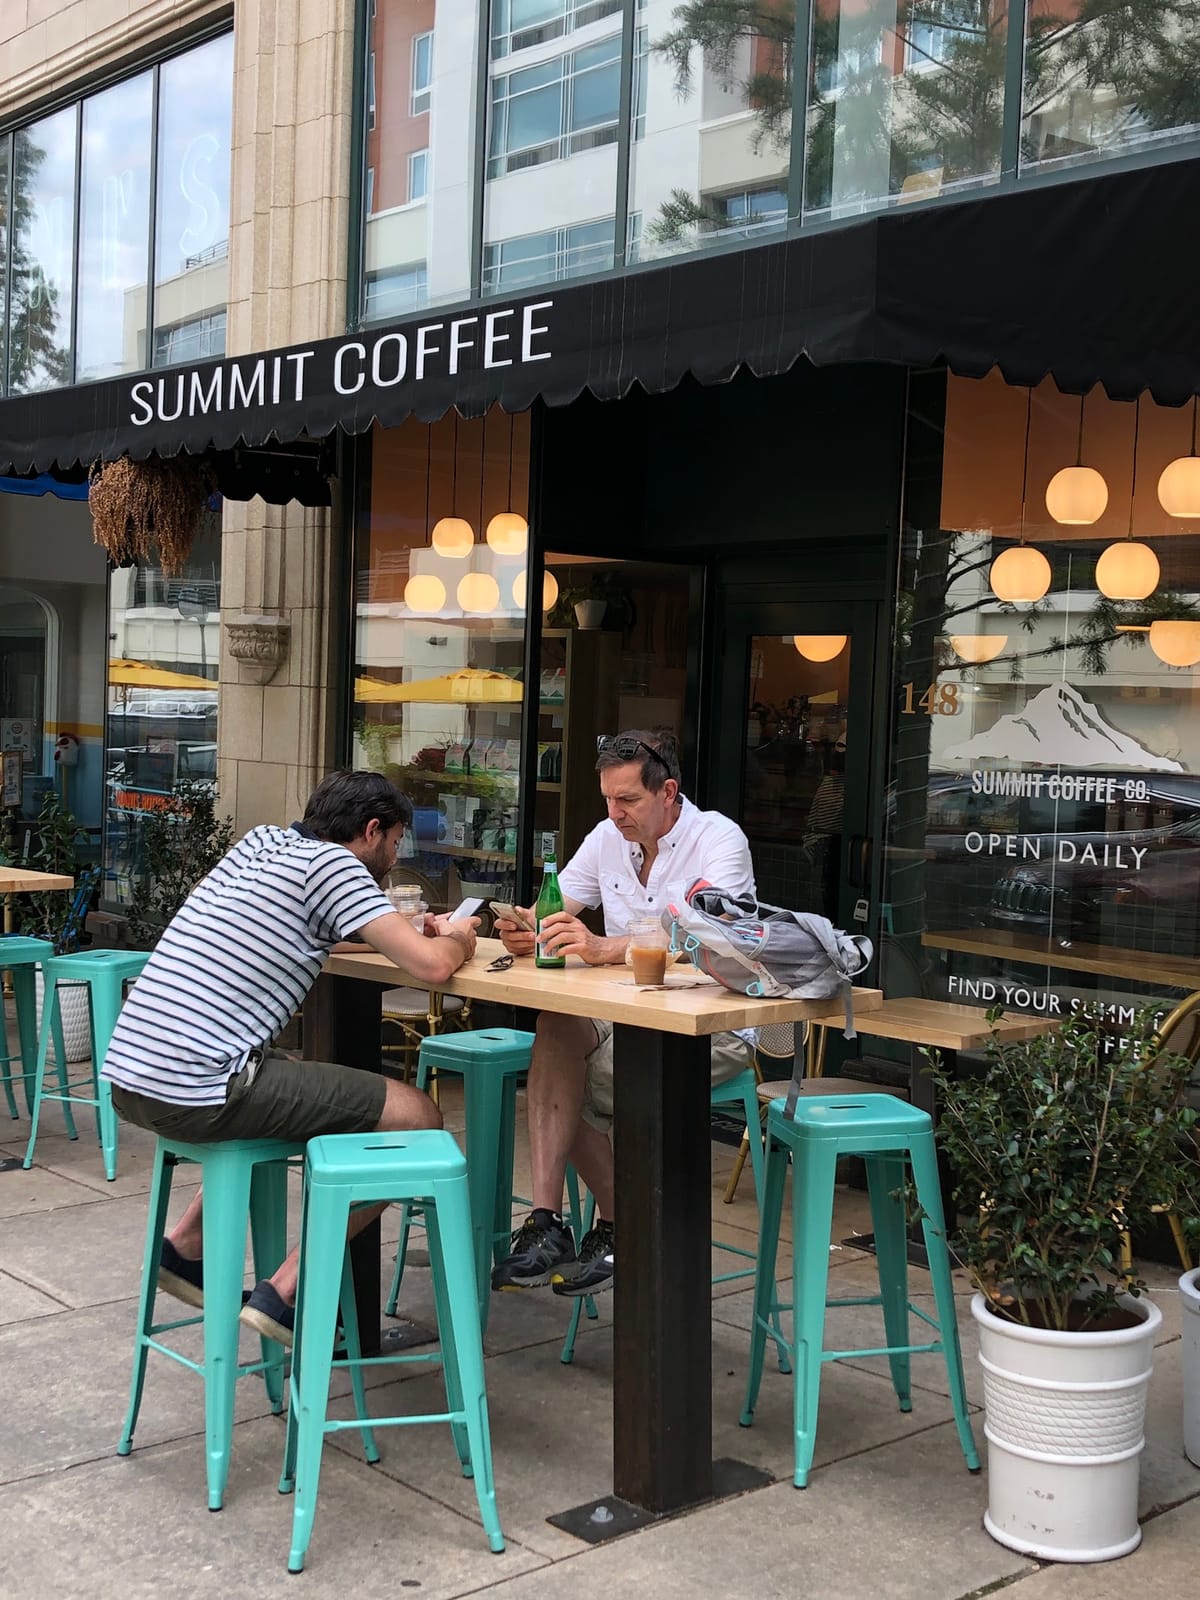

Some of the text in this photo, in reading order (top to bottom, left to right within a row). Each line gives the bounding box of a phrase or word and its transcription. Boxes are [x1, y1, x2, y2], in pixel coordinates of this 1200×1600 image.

[129, 300, 554, 426] SUMMIT COFFEE
[901, 682, 958, 717] 148
[971, 769, 1151, 804] SUMMIT COFFEE CO.
[964, 831, 1148, 871] OPEN DAILY
[948, 975, 997, 1001] FIND
[1002, 985, 1062, 1014] YOUR
